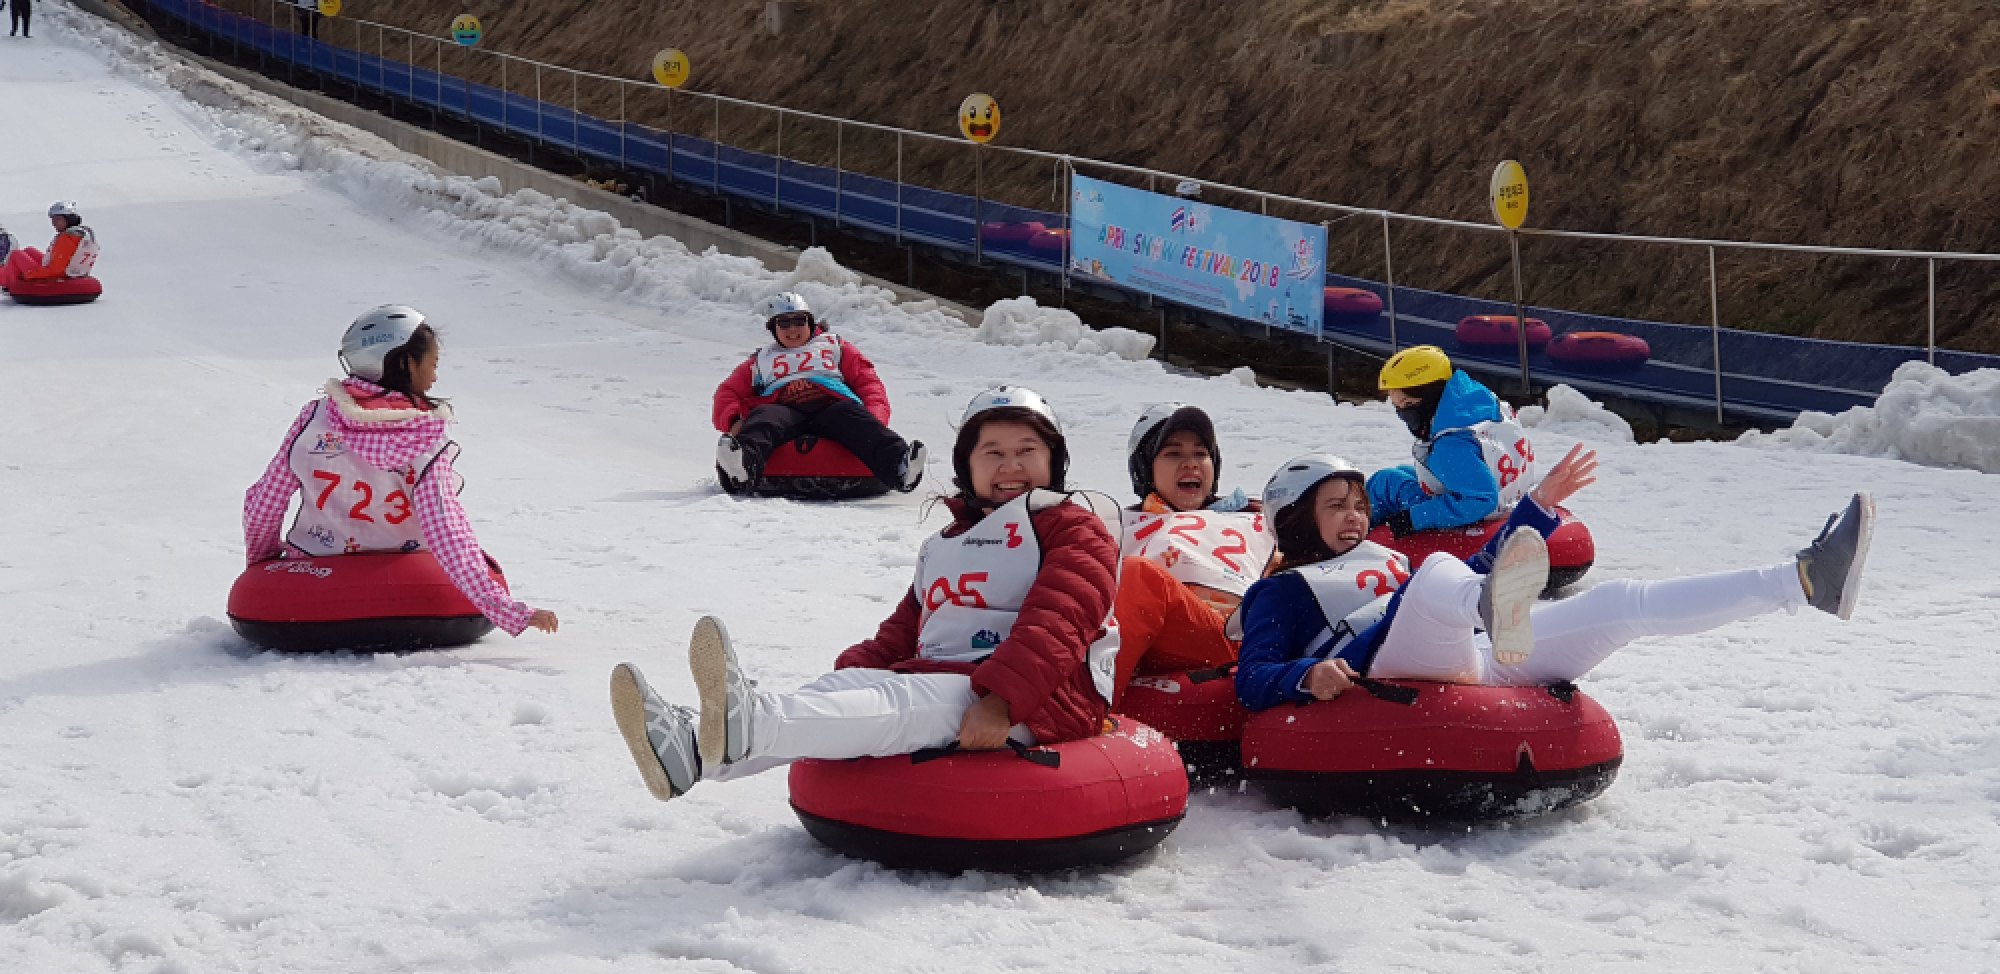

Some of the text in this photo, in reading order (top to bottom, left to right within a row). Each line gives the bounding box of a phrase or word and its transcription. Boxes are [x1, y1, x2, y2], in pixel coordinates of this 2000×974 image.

[1098, 223, 1129, 250] APRIL
[1133, 232, 1178, 263] SNOW
[1179, 245, 1237, 279] FESTIVAL
[1240, 258, 1280, 288] 2018
[772, 349, 837, 379] 525
[312, 469, 412, 525] 723
